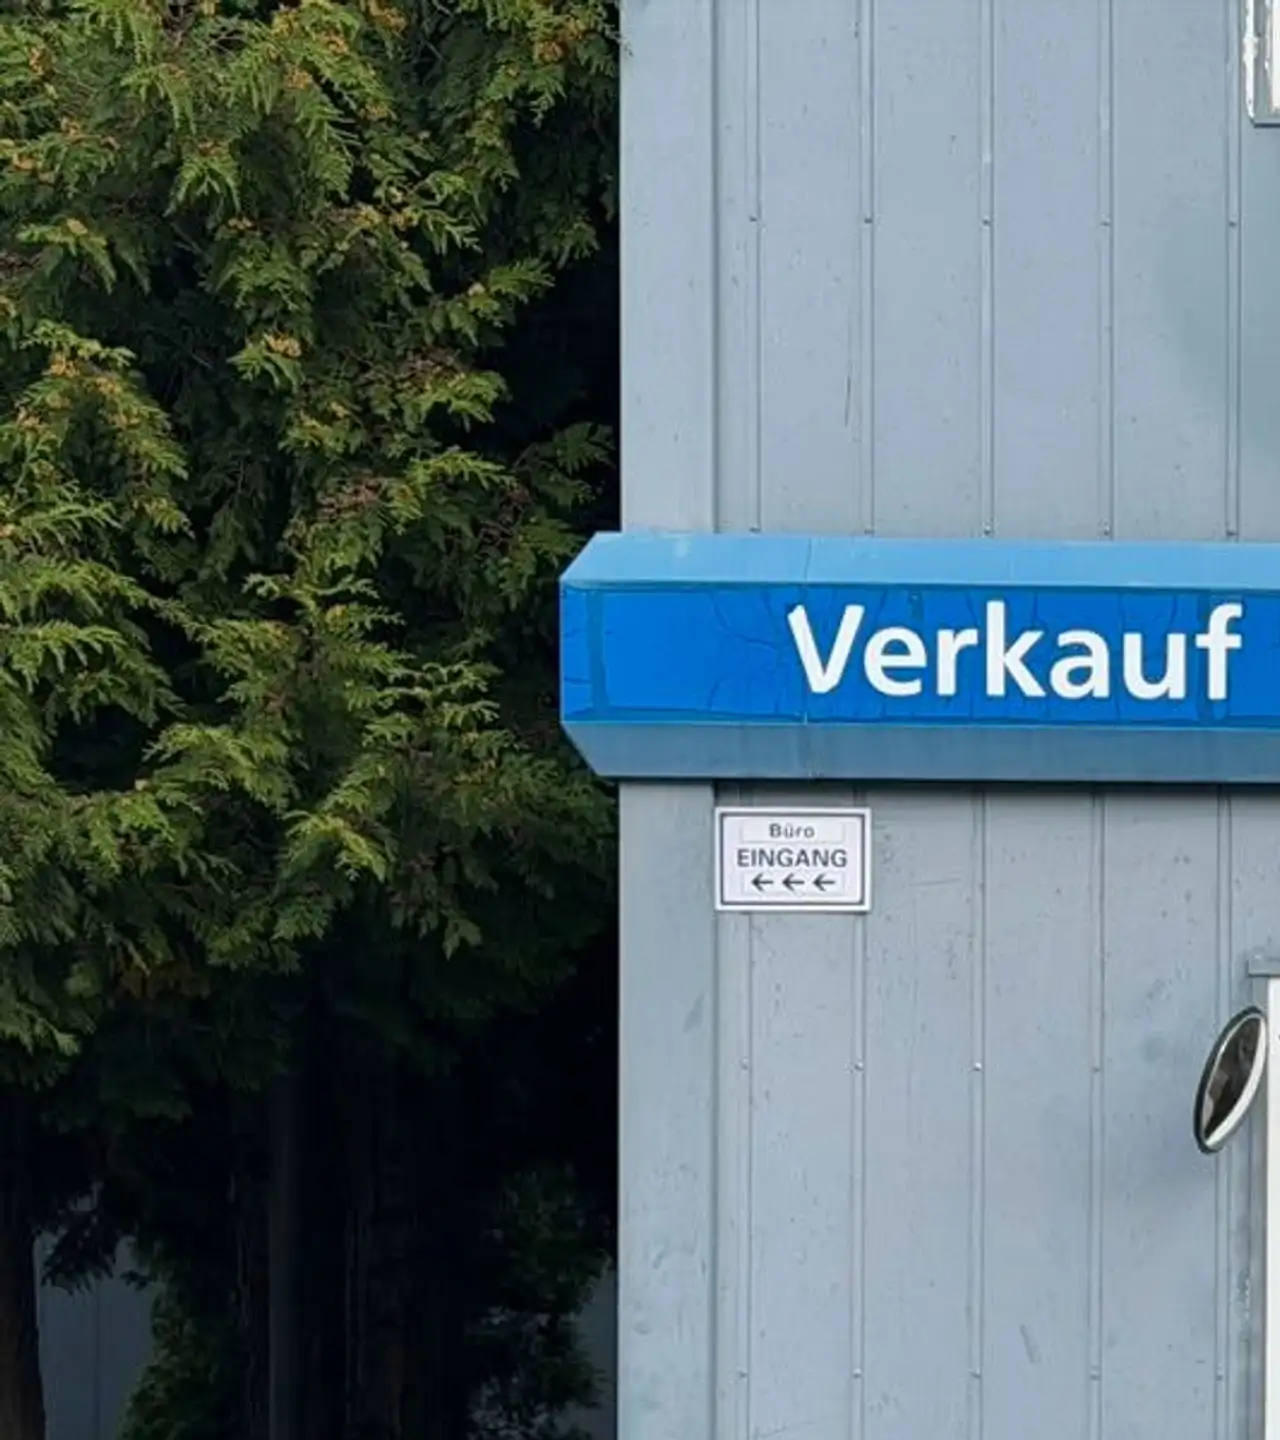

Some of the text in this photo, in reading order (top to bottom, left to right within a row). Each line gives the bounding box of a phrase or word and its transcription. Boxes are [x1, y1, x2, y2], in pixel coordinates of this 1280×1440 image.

[789, 602, 1241, 700] Verkauf
[769, 823, 815, 838] Büro
[737, 849, 848, 868] EINGANG
